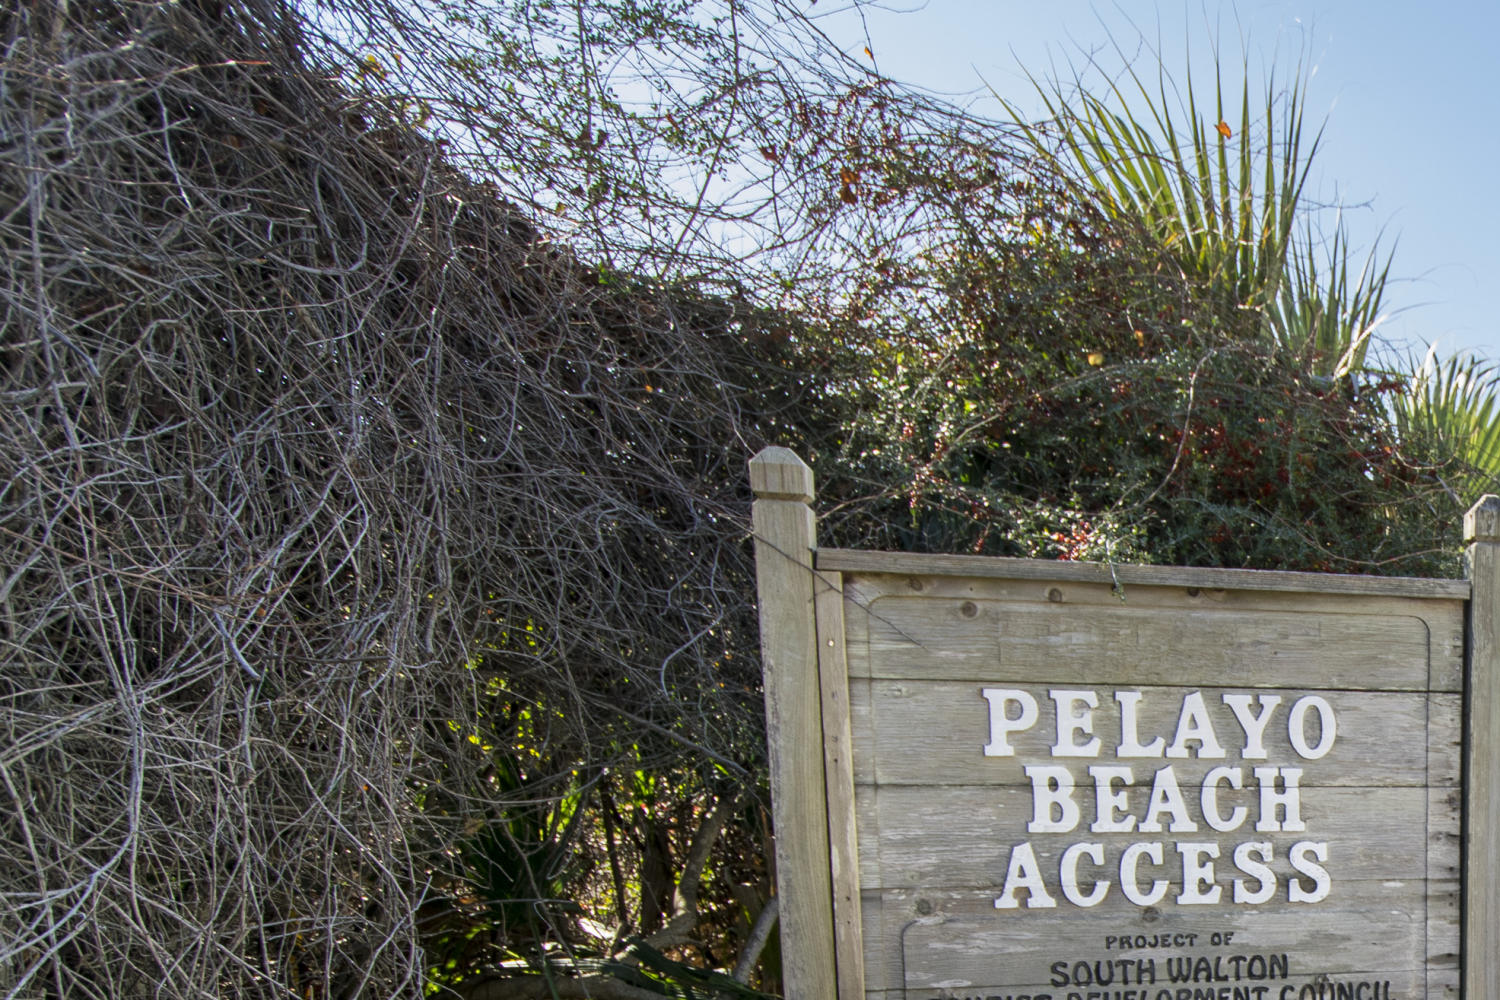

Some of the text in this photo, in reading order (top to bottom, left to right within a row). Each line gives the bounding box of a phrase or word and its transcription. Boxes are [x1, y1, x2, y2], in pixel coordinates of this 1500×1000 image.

[982, 688, 1337, 760] PELAYO
[1024, 764, 1306, 834] BEACH
[994, 842, 1332, 909] ACCESS
[1050, 953, 1289, 988] SOUTH WALTON
[1105, 932, 1235, 950] PROJECT OF
